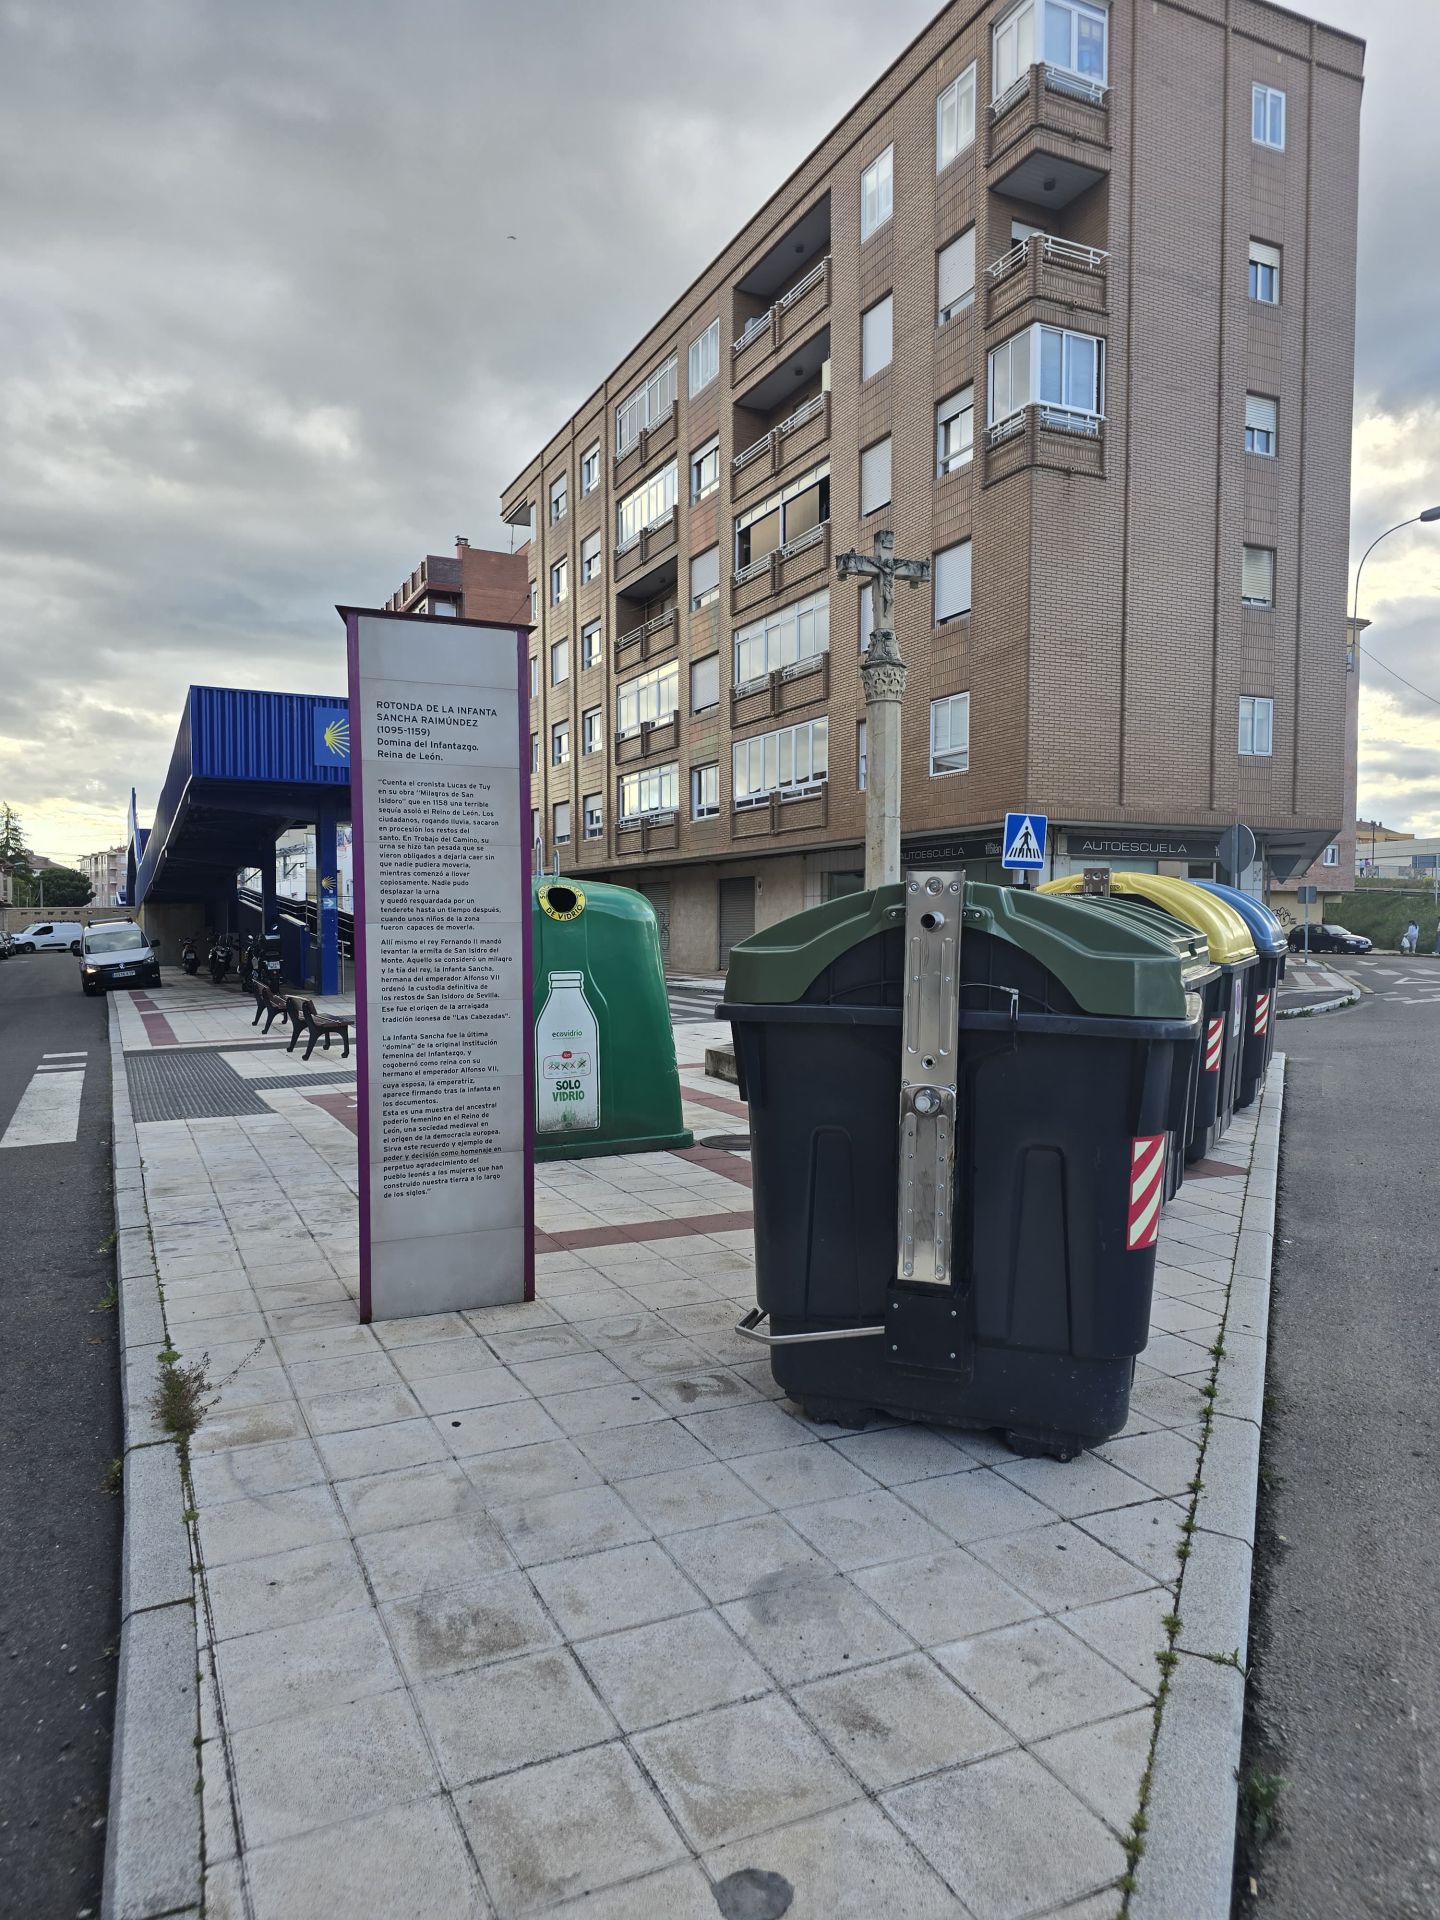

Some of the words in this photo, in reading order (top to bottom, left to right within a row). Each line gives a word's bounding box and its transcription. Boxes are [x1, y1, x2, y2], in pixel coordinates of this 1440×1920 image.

[377, 701, 423, 711] ROTONDA
[426, 704, 439, 712] DE
[458, 706, 497, 716] INFANTA
[377, 713, 418, 723] SANCHA
[421, 716, 478, 727] RAIMÚNDEZ
[377, 726, 430, 737] (1095-1159)
[378, 738, 411, 747] Domina
[430, 741, 478, 752] Infantazgo.
[378, 750, 402, 758] Reina
[419, 752, 443, 761] León.
[1082, 840, 1188, 853] AUTOESCUELA
[546, 907, 556, 917] DE
[558, 904, 582, 920] VIDRIO
[556, 1080, 580, 1090] SOLO
[552, 1090, 585, 1102] VIDRIO
[466, 1102, 496, 1110] ancestral
[433, 1131, 471, 1139] democracia
[458, 1139, 483, 1147] ejemplo
[384, 1155, 403, 1163] poder
[460, 1147, 492, 1156] homenaje
[384, 1164, 414, 1172] perpetuo
[416, 1159, 467, 1169] agradecimiento
[384, 1173, 406, 1182] pueblo
[384, 1180, 420, 1190] construido
